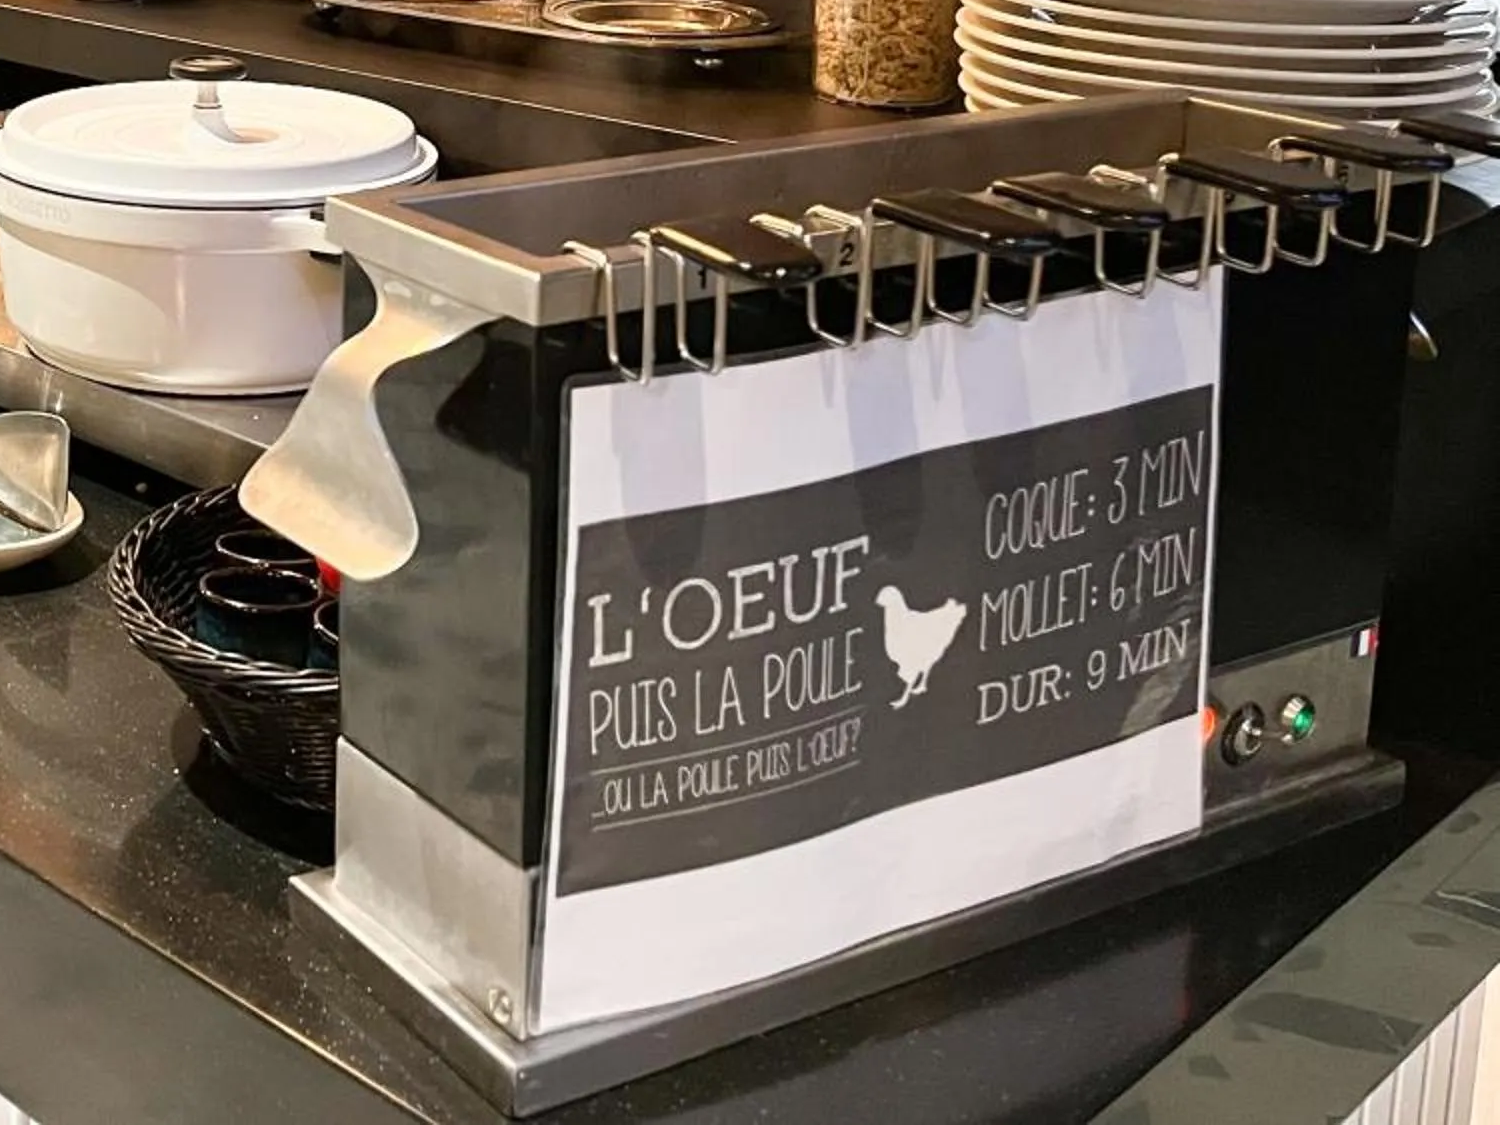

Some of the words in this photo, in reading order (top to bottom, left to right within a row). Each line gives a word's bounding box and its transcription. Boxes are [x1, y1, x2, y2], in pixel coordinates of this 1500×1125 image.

[839, 242, 855, 267] 2
[985, 468, 1095, 560] COQUE:
[1108, 456, 1130, 525] 3
[1138, 430, 1205, 516] MIN
[587, 534, 870, 668] L'OEUF
[980, 562, 1098, 652] MOLLET:
[1110, 552, 1126, 612] 6
[1135, 526, 1196, 605] MIN
[588, 676, 678, 756] PUIS
[695, 666, 746, 735] LA
[763, 627, 864, 719] POULE
[977, 663, 1072, 725] DUR:
[1087, 649, 1107, 692] 9
[1117, 618, 1192, 682] MIN
[639, 771, 669, 810] LA
[677, 755, 739, 803] POULE
[746, 742, 791, 786] PUIS
[797, 716, 862, 772] L'OEUF?
